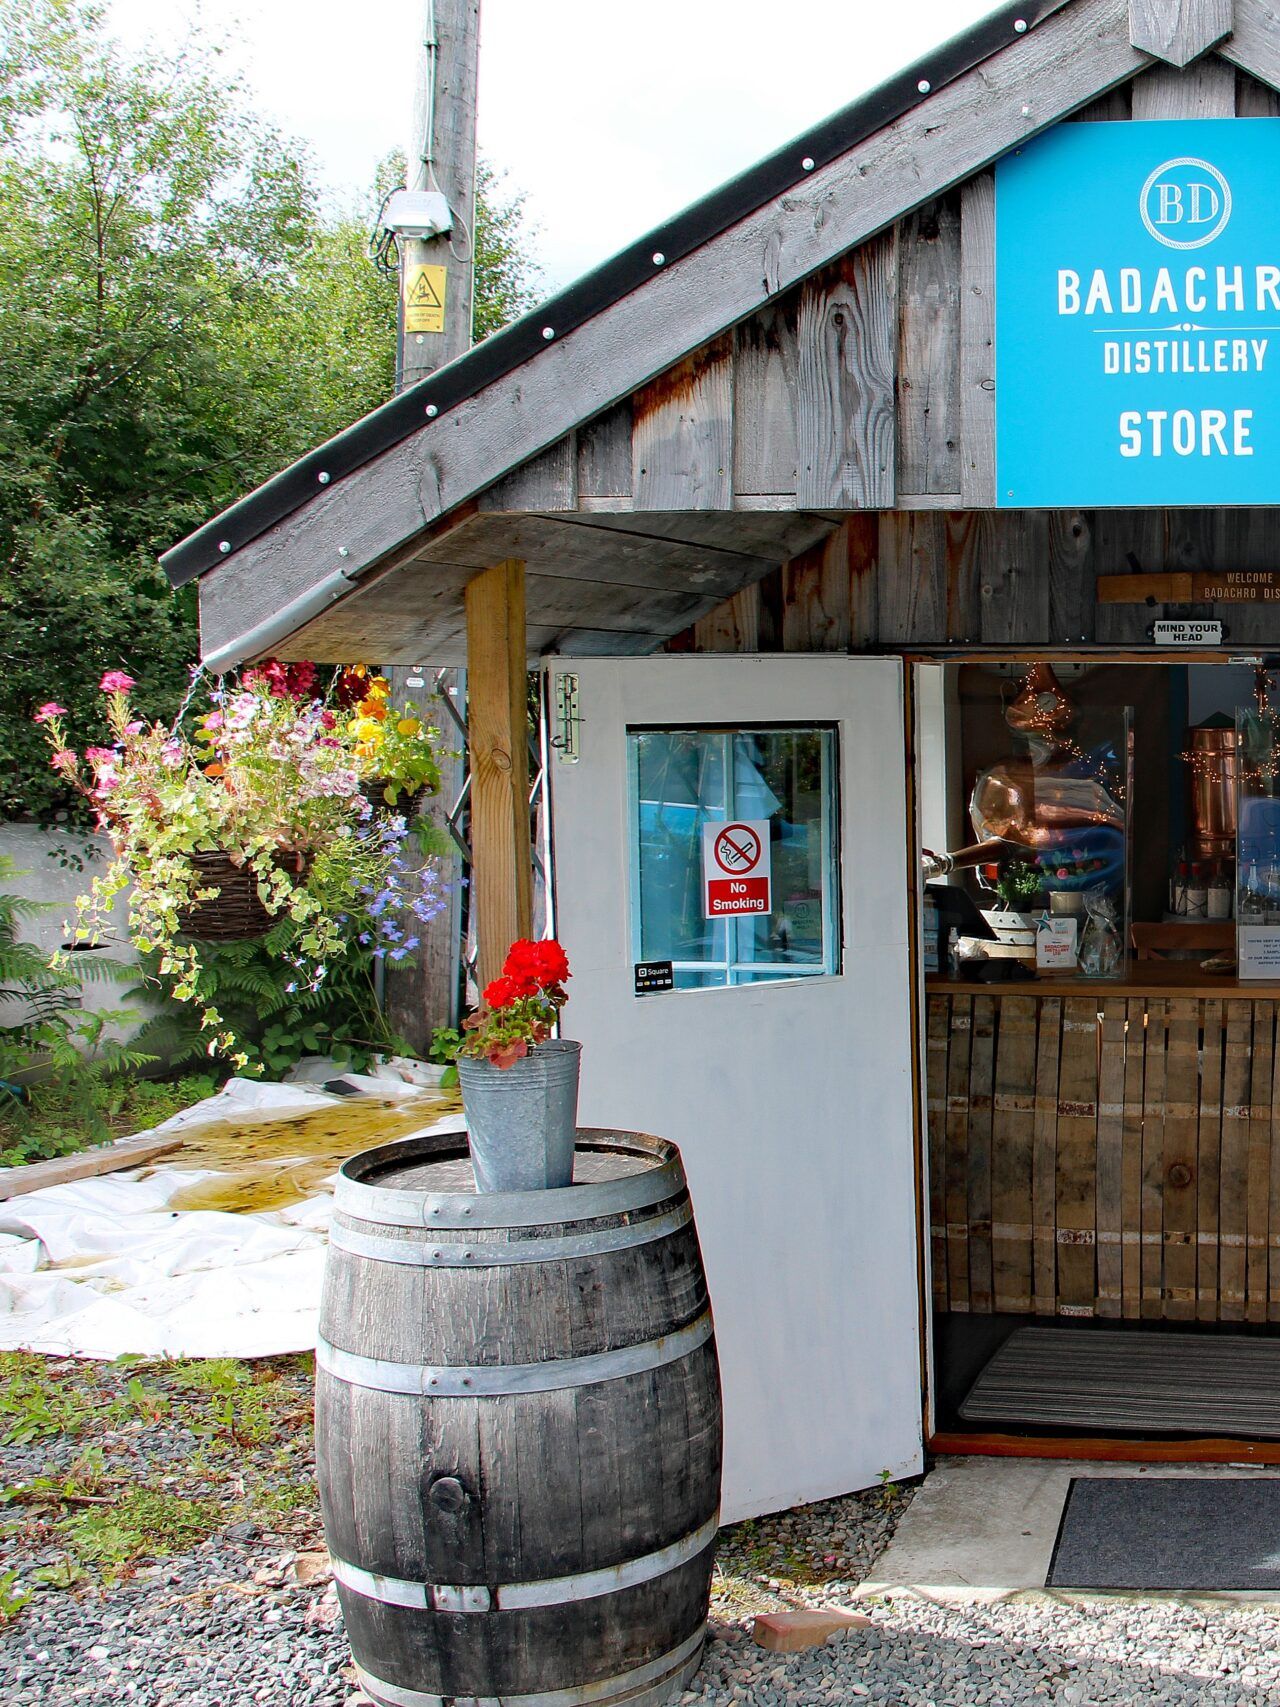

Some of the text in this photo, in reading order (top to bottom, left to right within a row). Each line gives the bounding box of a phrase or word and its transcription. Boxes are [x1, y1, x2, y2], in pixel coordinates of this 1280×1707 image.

[1155, 183, 1219, 224] BD
[1104, 338, 1269, 375] DISTILLERY
[1119, 408, 1254, 458] STORE
[1227, 572, 1273, 584] WELCOME
[1204, 586, 1257, 599] BADACHRO
[1157, 624, 1218, 633] MIND YOUR
[1172, 632, 1203, 642] HEAD
[730, 882, 747, 894] No
[713, 898, 764, 911] Smoking
[647, 968, 669, 976] Square
